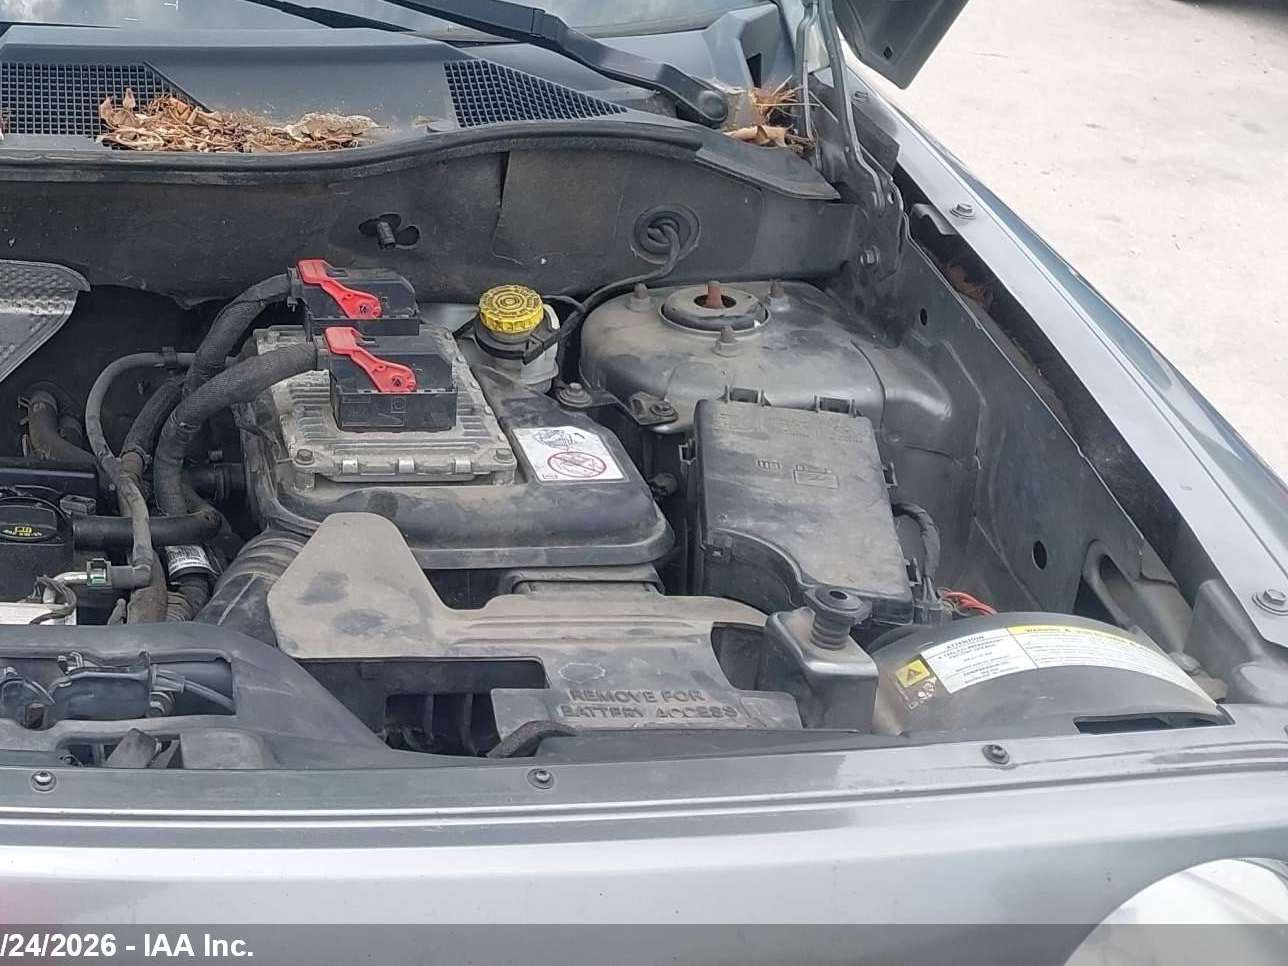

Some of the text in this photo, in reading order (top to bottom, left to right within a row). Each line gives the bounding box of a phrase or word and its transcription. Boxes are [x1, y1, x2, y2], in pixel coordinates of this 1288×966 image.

[569, 689, 706, 703] REMOVE FOR
[561, 705, 739, 719] BATTERY ACCESS
